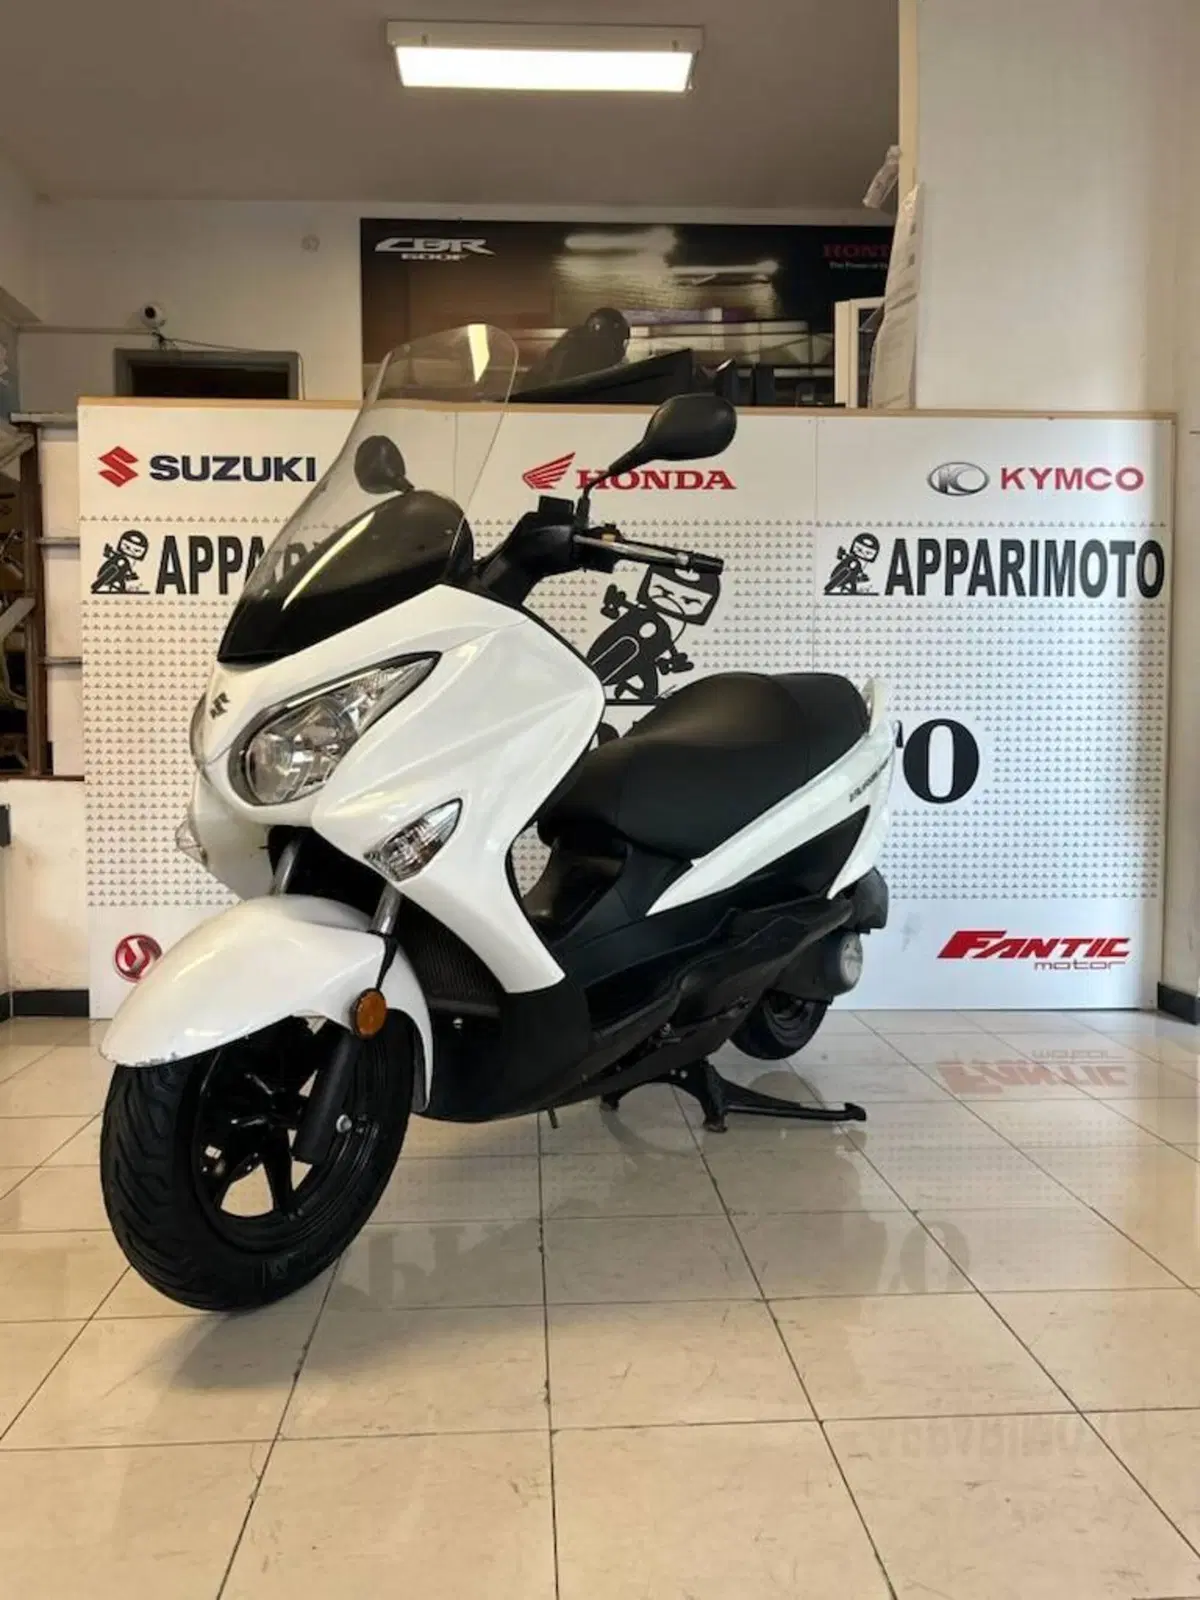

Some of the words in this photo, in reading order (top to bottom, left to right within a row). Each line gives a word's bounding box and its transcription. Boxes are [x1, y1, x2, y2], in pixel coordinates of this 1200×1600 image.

[374, 237, 496, 255] CBR
[149, 455, 316, 482] SUZUKI
[576, 470, 736, 490] HONDA
[1000, 467, 1144, 491] KYMCO
[884, 538, 1165, 598] APPARIMOTO
[937, 930, 1131, 959] FANTIC
[1034, 959, 1126, 971] motor
